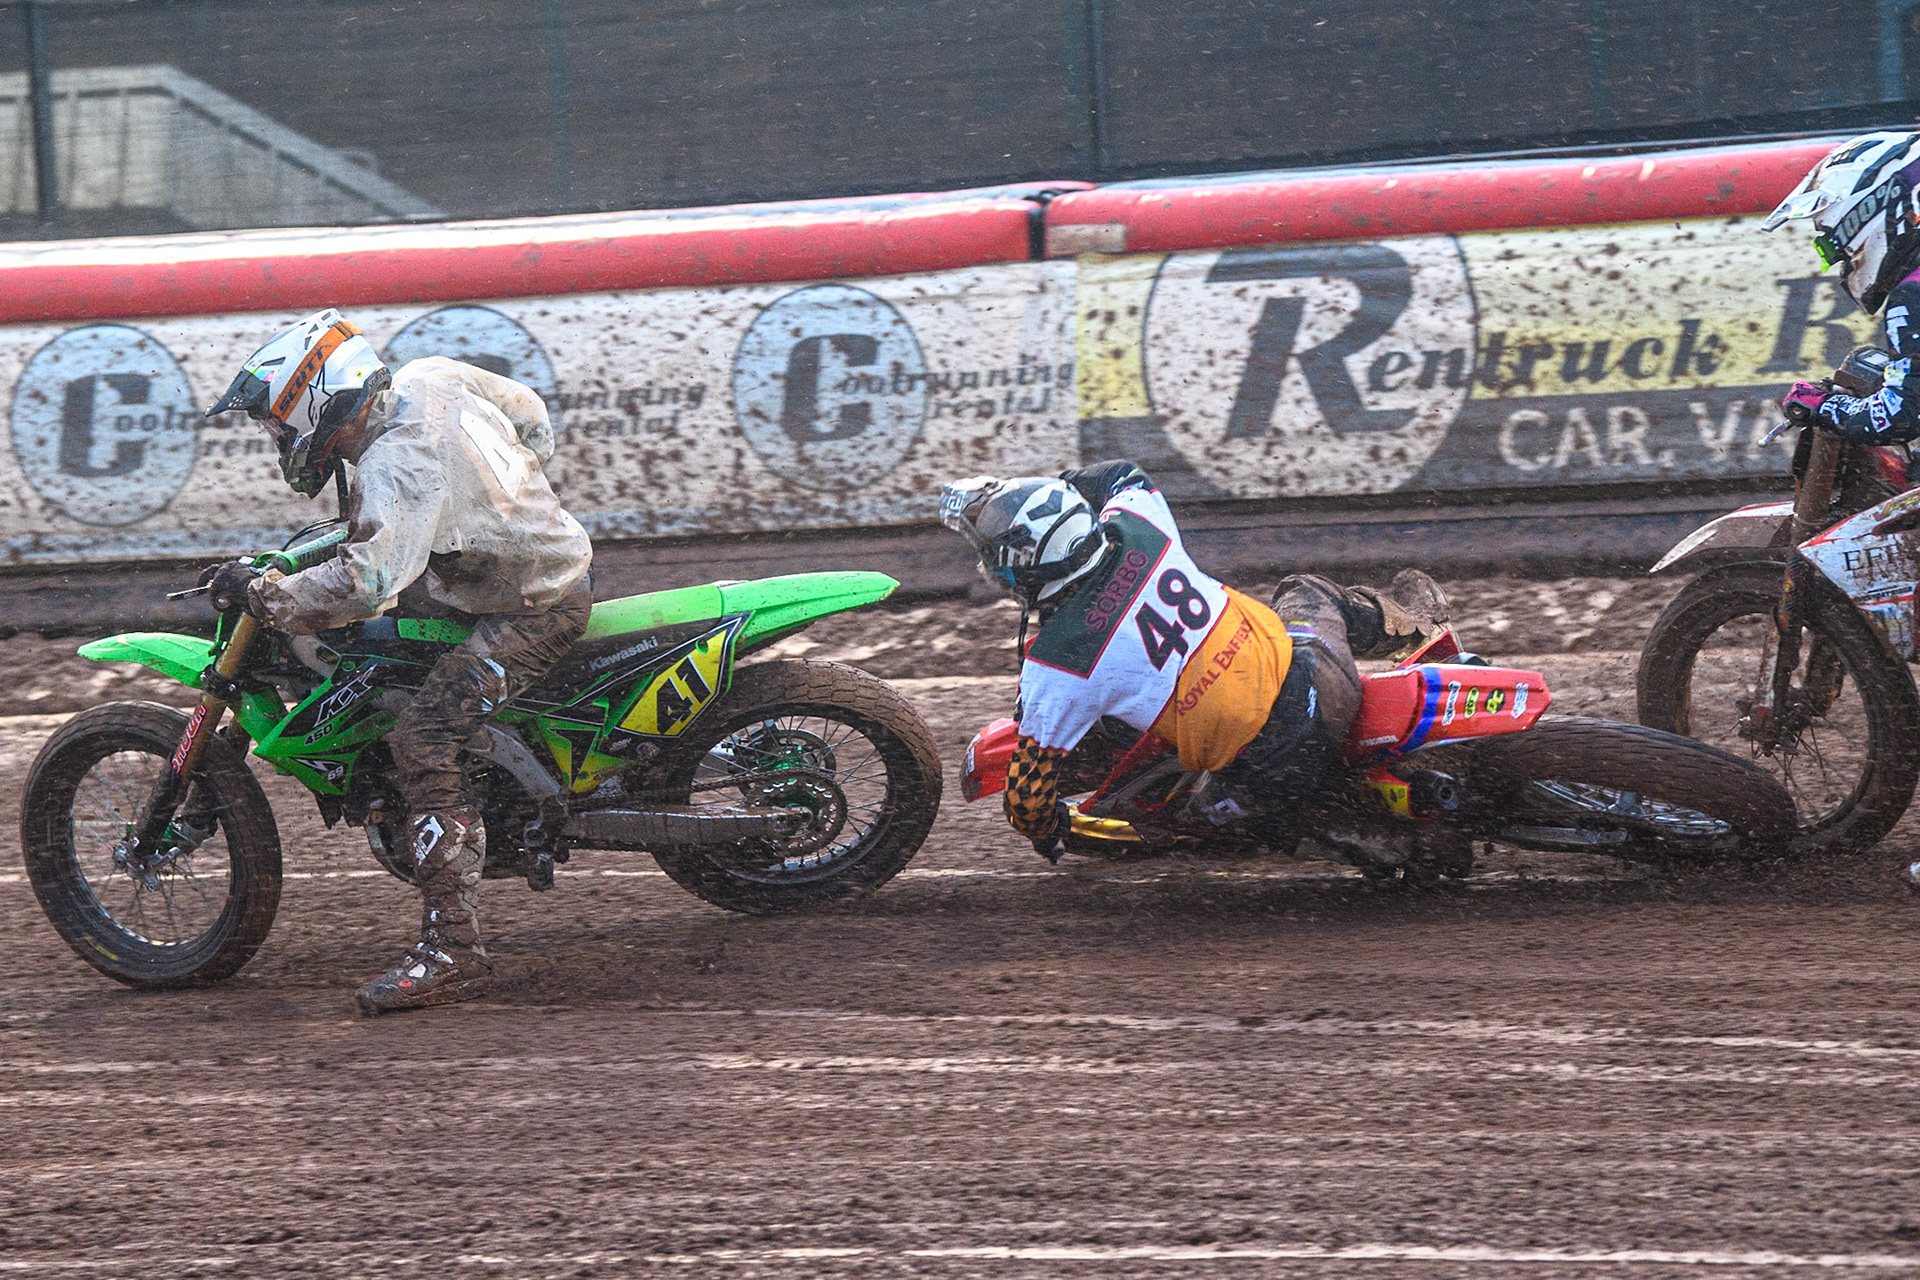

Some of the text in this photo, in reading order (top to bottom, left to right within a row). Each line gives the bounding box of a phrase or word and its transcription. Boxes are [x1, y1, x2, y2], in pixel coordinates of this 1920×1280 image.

[1834, 176, 1901, 246] 100%
[279, 344, 331, 415] SCOTT
[1135, 568, 1211, 672] 48
[589, 635, 659, 671] Kawasaki
[656, 654, 713, 735] 41
[1176, 669, 1221, 716] ROYAL
[304, 722, 333, 746] 450
[327, 765, 344, 781] 69
